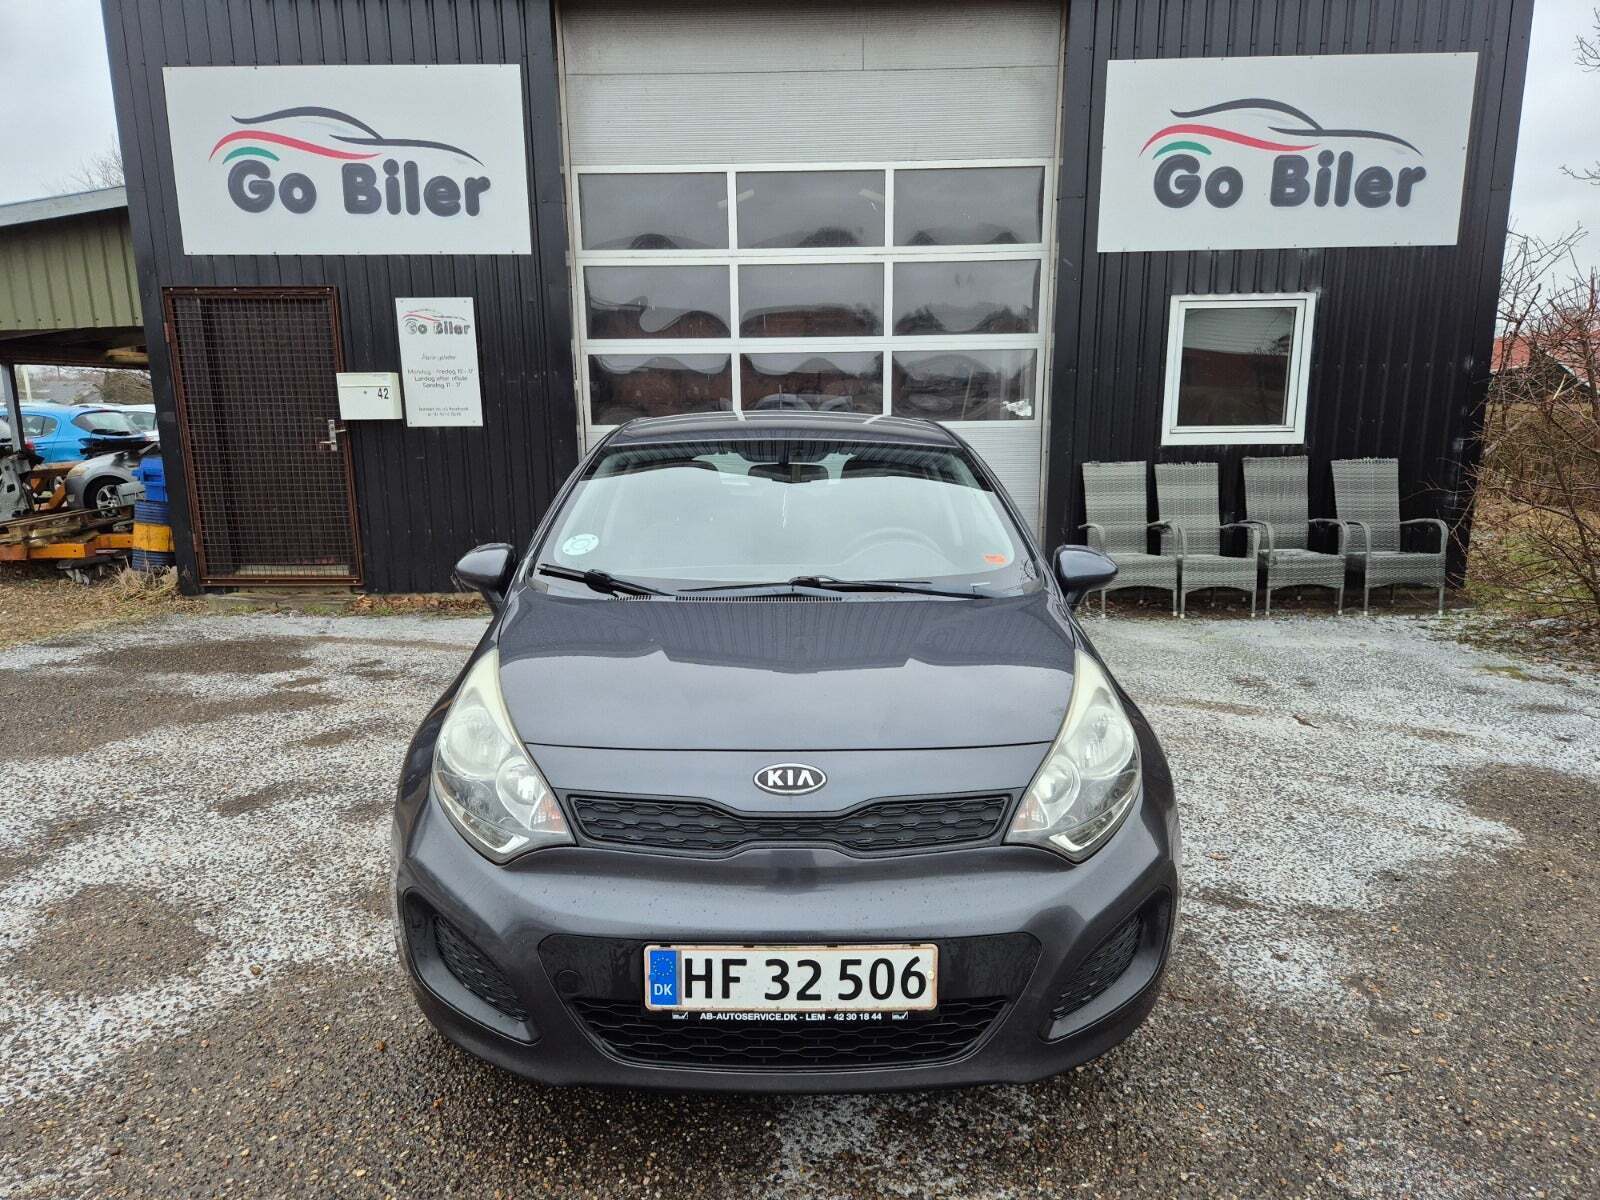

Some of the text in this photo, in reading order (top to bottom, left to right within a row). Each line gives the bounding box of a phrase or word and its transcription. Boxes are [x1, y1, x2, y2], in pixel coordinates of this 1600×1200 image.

[1153, 149, 1427, 209] Go Biler
[227, 158, 491, 217] Go Biler
[405, 320, 471, 336] Go Biler
[377, 387, 389, 399] 42
[767, 769, 815, 786] KIA
[684, 956, 927, 1001] HF 32 506
[654, 983, 673, 996] DK
[699, 1012, 798, 1021] AB-AUTOSERVICE.DK
[805, 1012, 826, 1021] LEM
[833, 1012, 845, 1021] 42
[846, 1012, 858, 1021] 30
[859, 1012, 870, 1021] 18
[871, 1012, 882, 1021] 44
